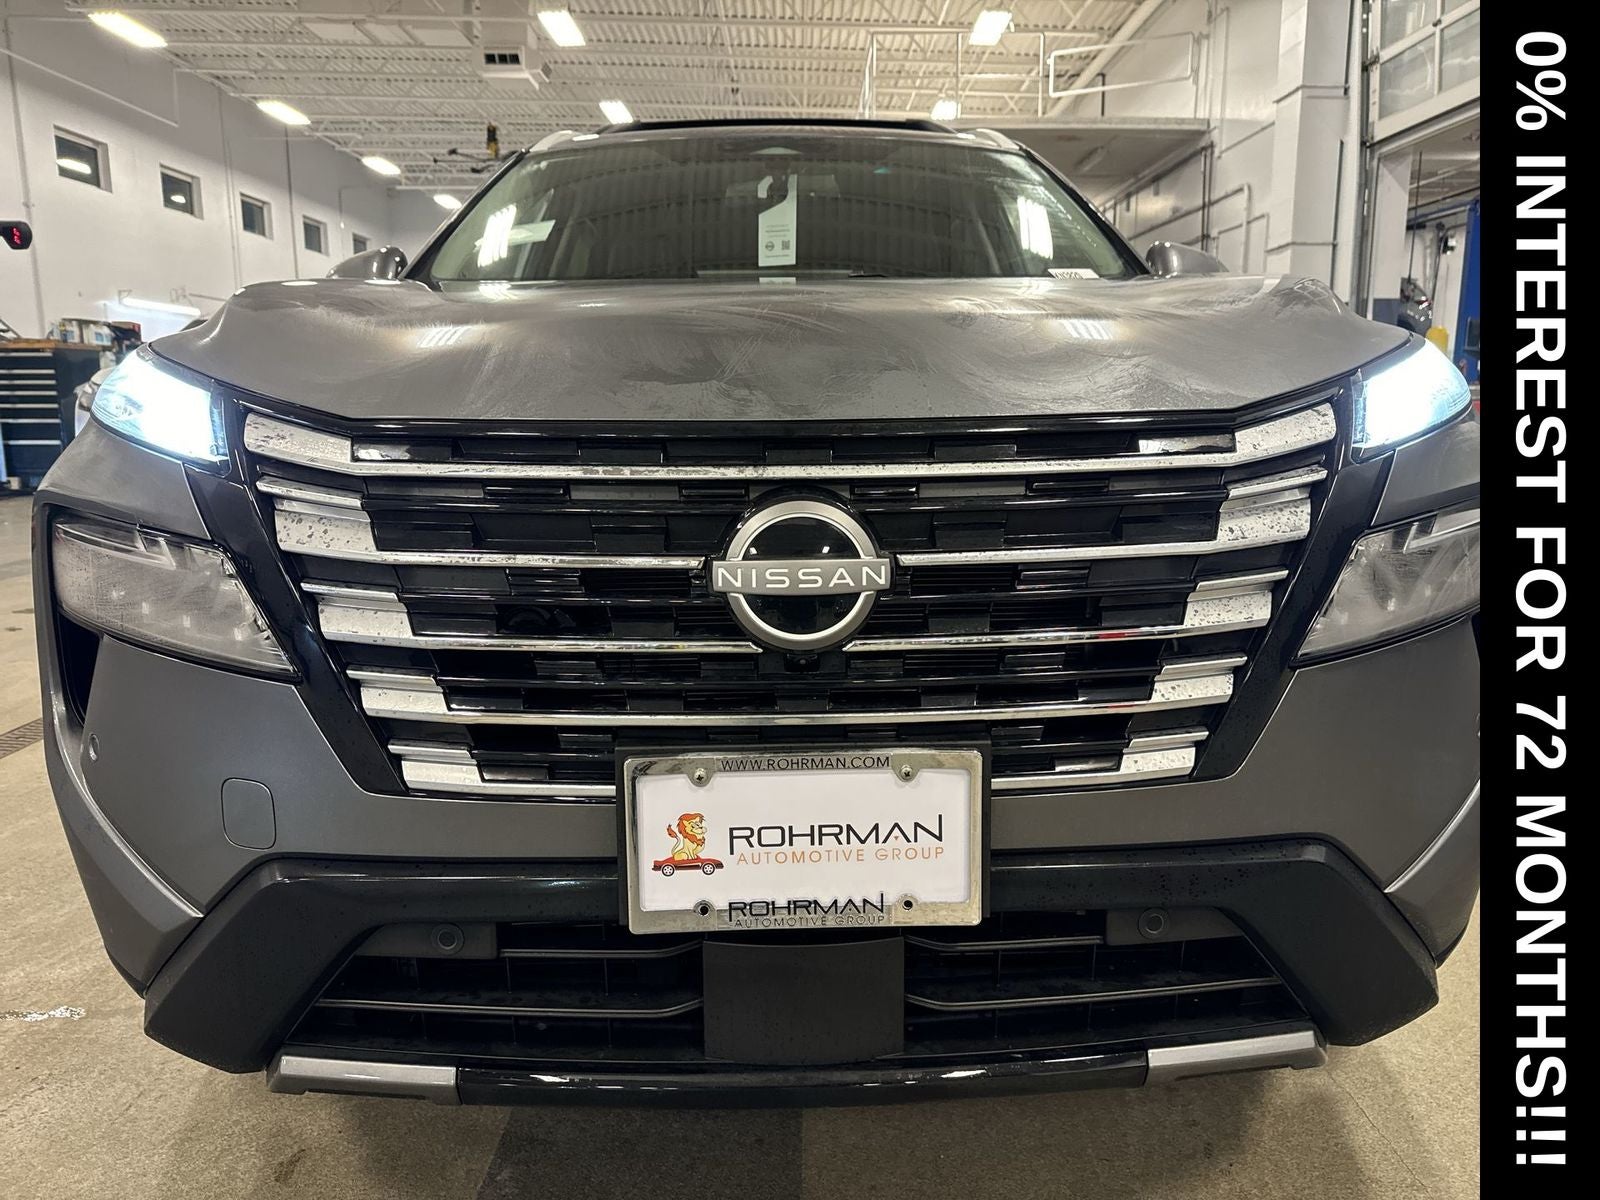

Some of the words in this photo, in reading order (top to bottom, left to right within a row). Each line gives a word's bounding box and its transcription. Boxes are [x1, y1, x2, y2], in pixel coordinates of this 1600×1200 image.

[717, 565, 886, 588] NISSAN
[720, 756, 890, 771] WWW.ROHRMAN.COM
[728, 814, 943, 856] ROHRMAN
[736, 848, 865, 866] AUTOMOTIVE
[874, 846, 945, 861] GROUP
[728, 892, 885, 922] ROHRMAN
[734, 915, 828, 928] AUTOMOTIVE
[834, 914, 886, 926] GROUP
